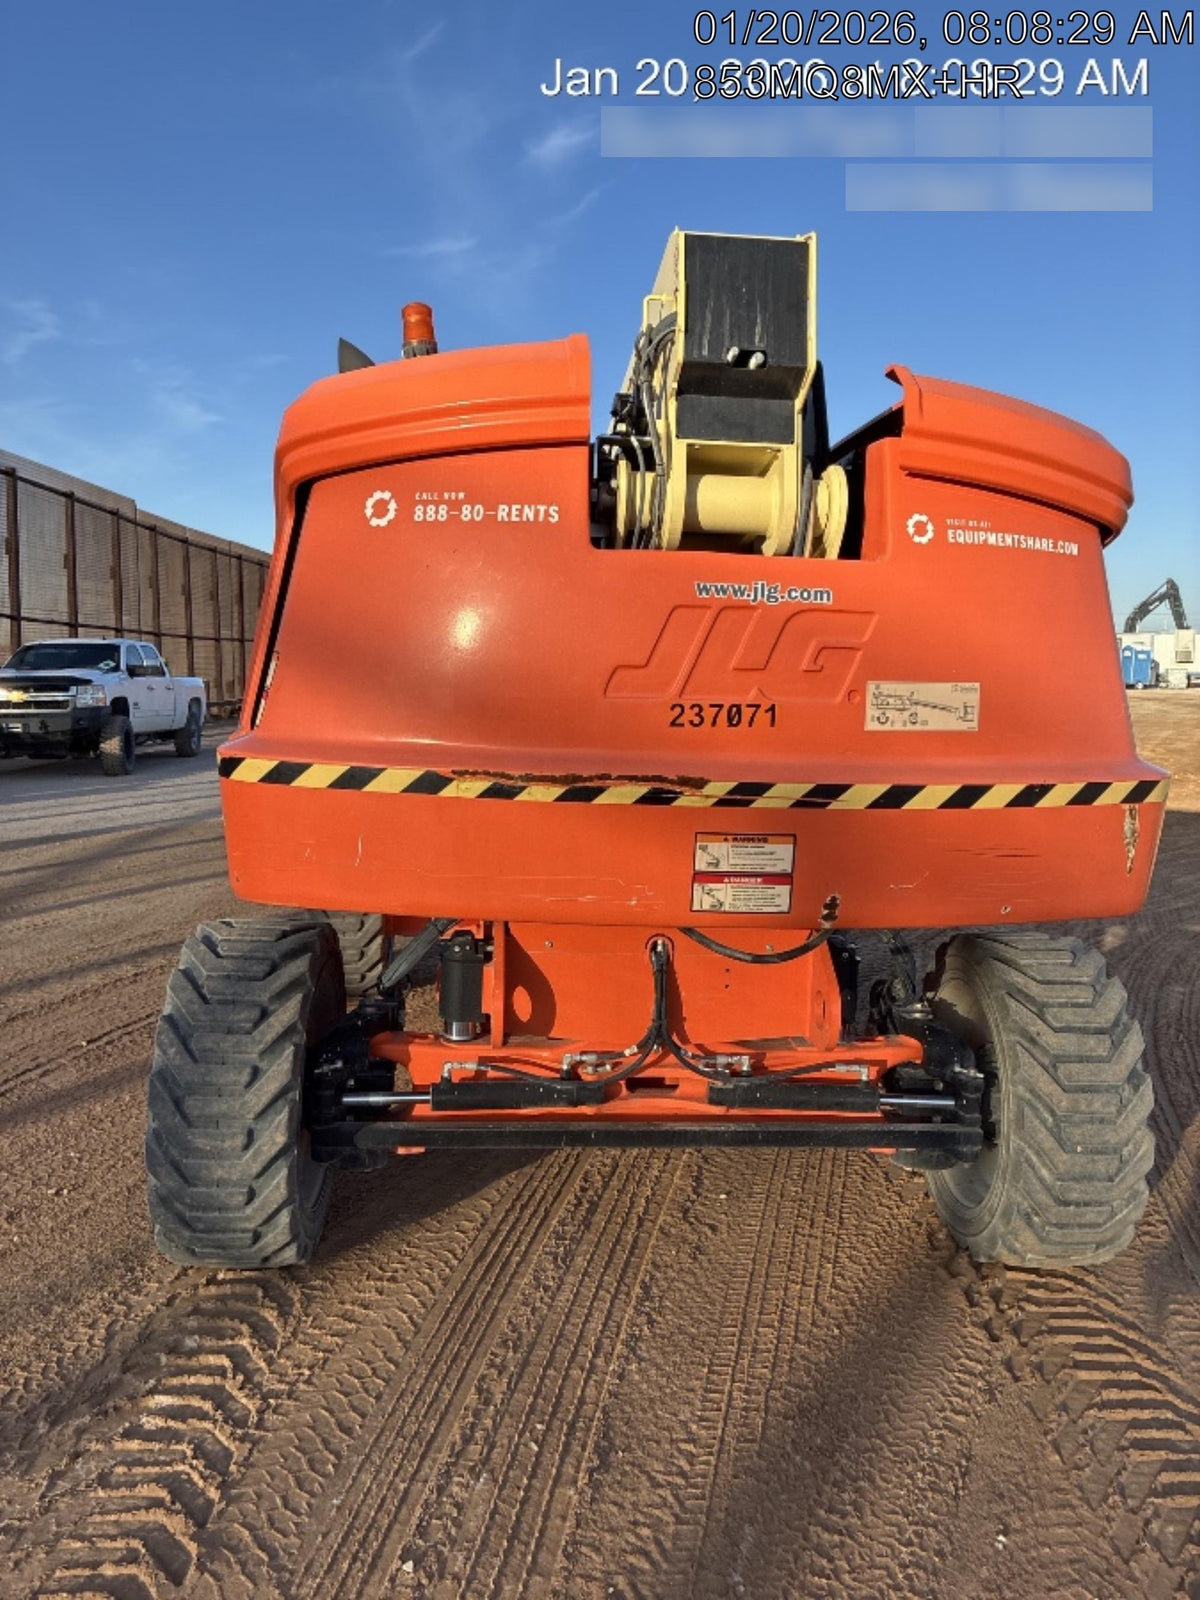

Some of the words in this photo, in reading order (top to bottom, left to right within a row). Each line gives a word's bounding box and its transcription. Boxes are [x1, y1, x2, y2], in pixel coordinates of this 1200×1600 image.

[415, 491, 439, 501] CALL
[413, 503, 560, 523] 888-80-RENTS
[947, 529, 1080, 556] EQUIPMENTSHARE.COM
[695, 581, 832, 604] www.jlg.com
[603, 604, 879, 701] JLG
[669, 703, 776, 727] 237071
